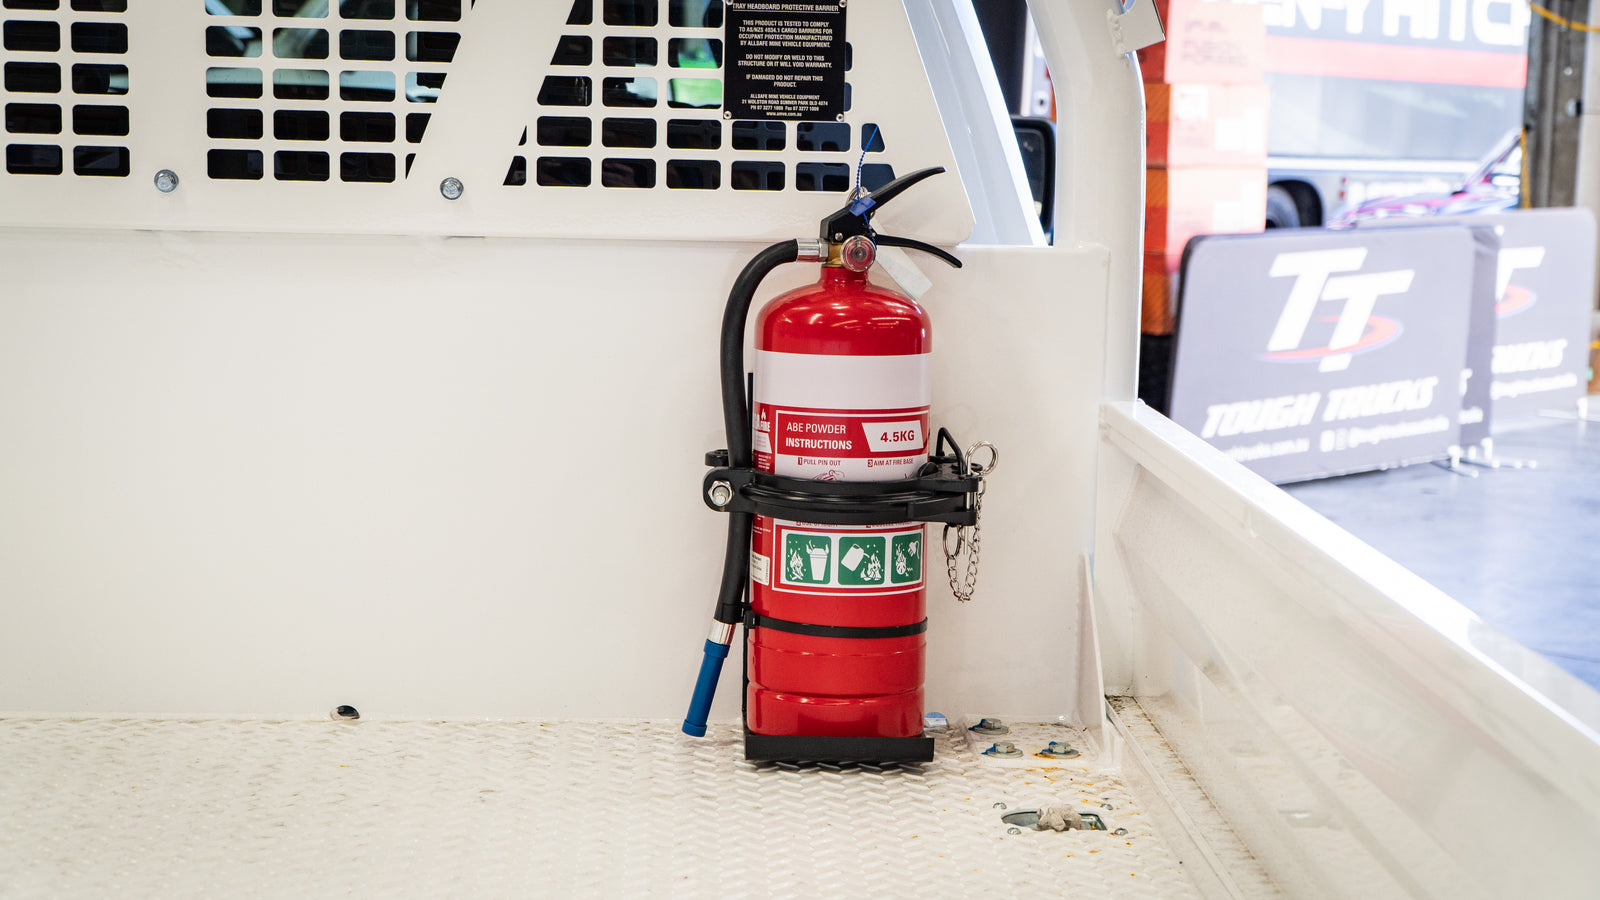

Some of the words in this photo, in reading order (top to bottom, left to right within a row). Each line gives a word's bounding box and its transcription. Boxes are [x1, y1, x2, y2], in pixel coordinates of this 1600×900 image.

[1201, 391, 1321, 439] TOUGH
[1322, 376, 1440, 423] TRUCKS
[786, 422, 804, 432] ABE
[806, 423, 846, 434] POWDER
[880, 430, 915, 443] 4.5KG
[786, 437, 852, 450] INSTRUCTIONS
